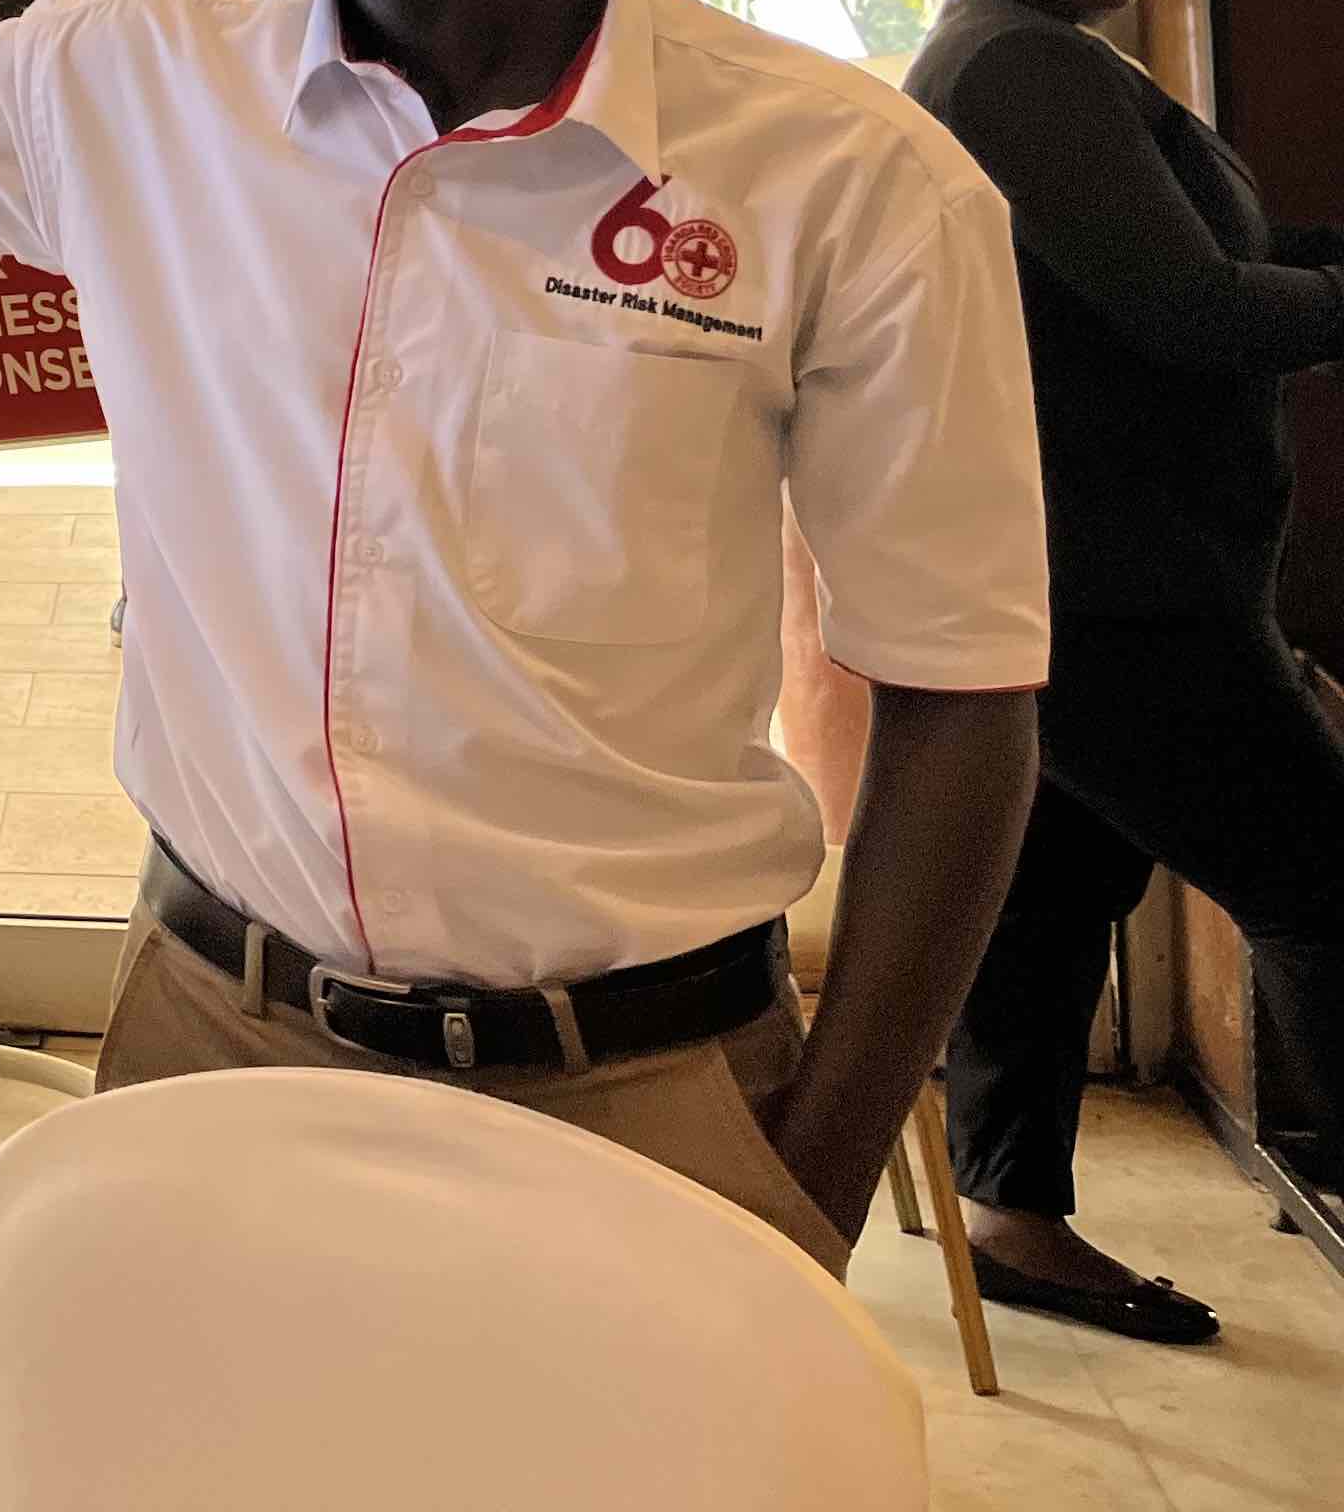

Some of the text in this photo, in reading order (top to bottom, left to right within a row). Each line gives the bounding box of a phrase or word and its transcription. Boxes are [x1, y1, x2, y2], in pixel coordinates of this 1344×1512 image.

[546, 277, 762, 341] Disaster Risk Management
